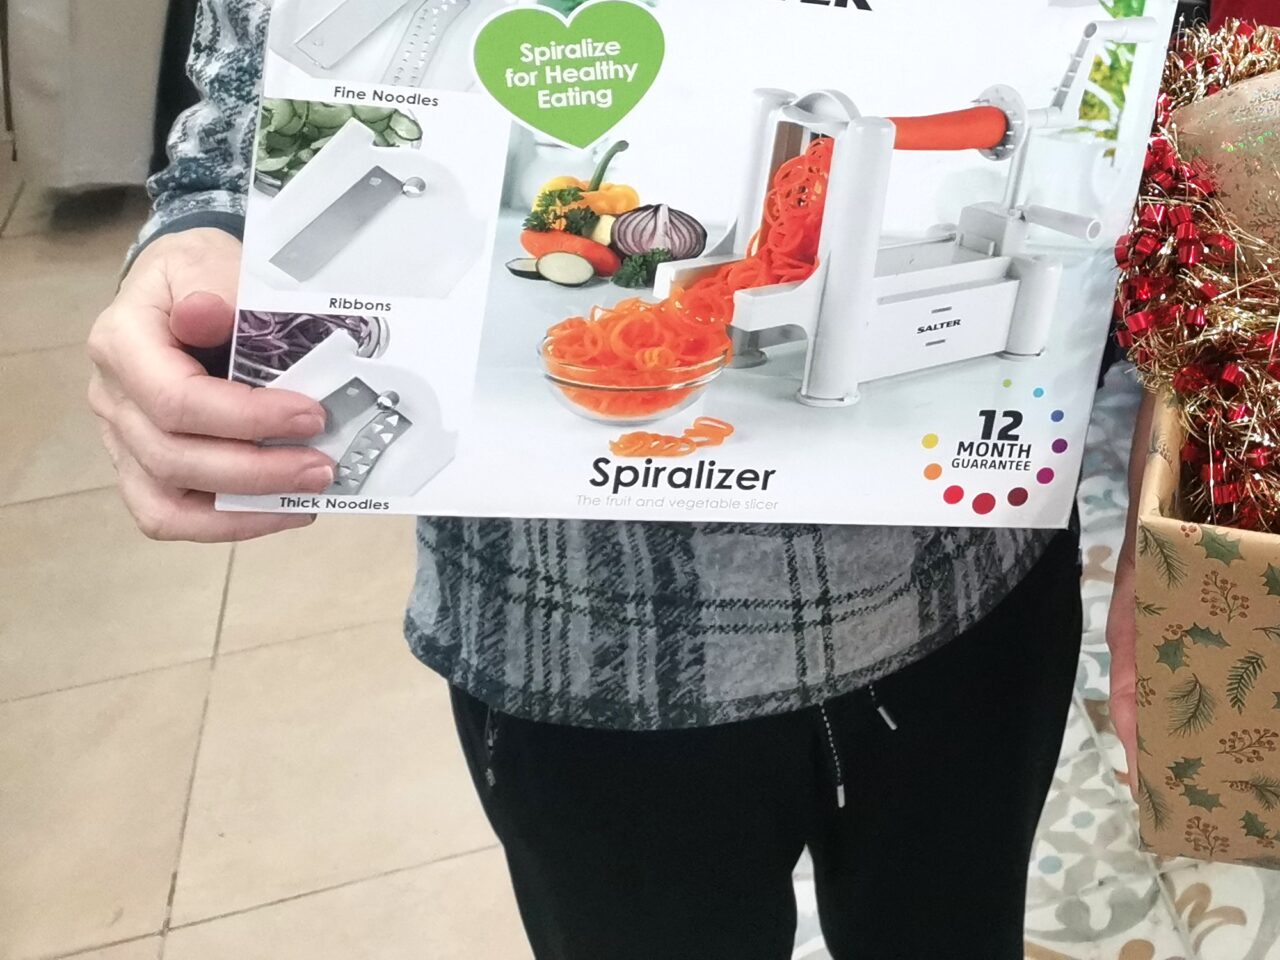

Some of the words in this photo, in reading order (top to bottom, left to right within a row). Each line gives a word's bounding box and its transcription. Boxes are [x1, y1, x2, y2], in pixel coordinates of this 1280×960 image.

[520, 38, 621, 65] Spiralize
[505, 67, 538, 88] for
[545, 60, 639, 84] Healthy
[334, 86, 366, 100] Fine
[372, 90, 439, 106] Noodles
[537, 86, 613, 109] Eating
[329, 297, 392, 311] Ribbons
[917, 319, 961, 334] SALTER
[979, 409, 1023, 441] 12
[956, 441, 1032, 458] MONTH
[952, 458, 1031, 471] GUARANTEE
[589, 457, 777, 494] Spiralizer
[280, 497, 320, 509] Thick
[326, 498, 390, 510] Noodles
[577, 494, 601, 506] The
[606, 495, 631, 507] fruit
[635, 496, 664, 508] and
[669, 497, 741, 510] vegetable
[744, 497, 779, 510] slicer
